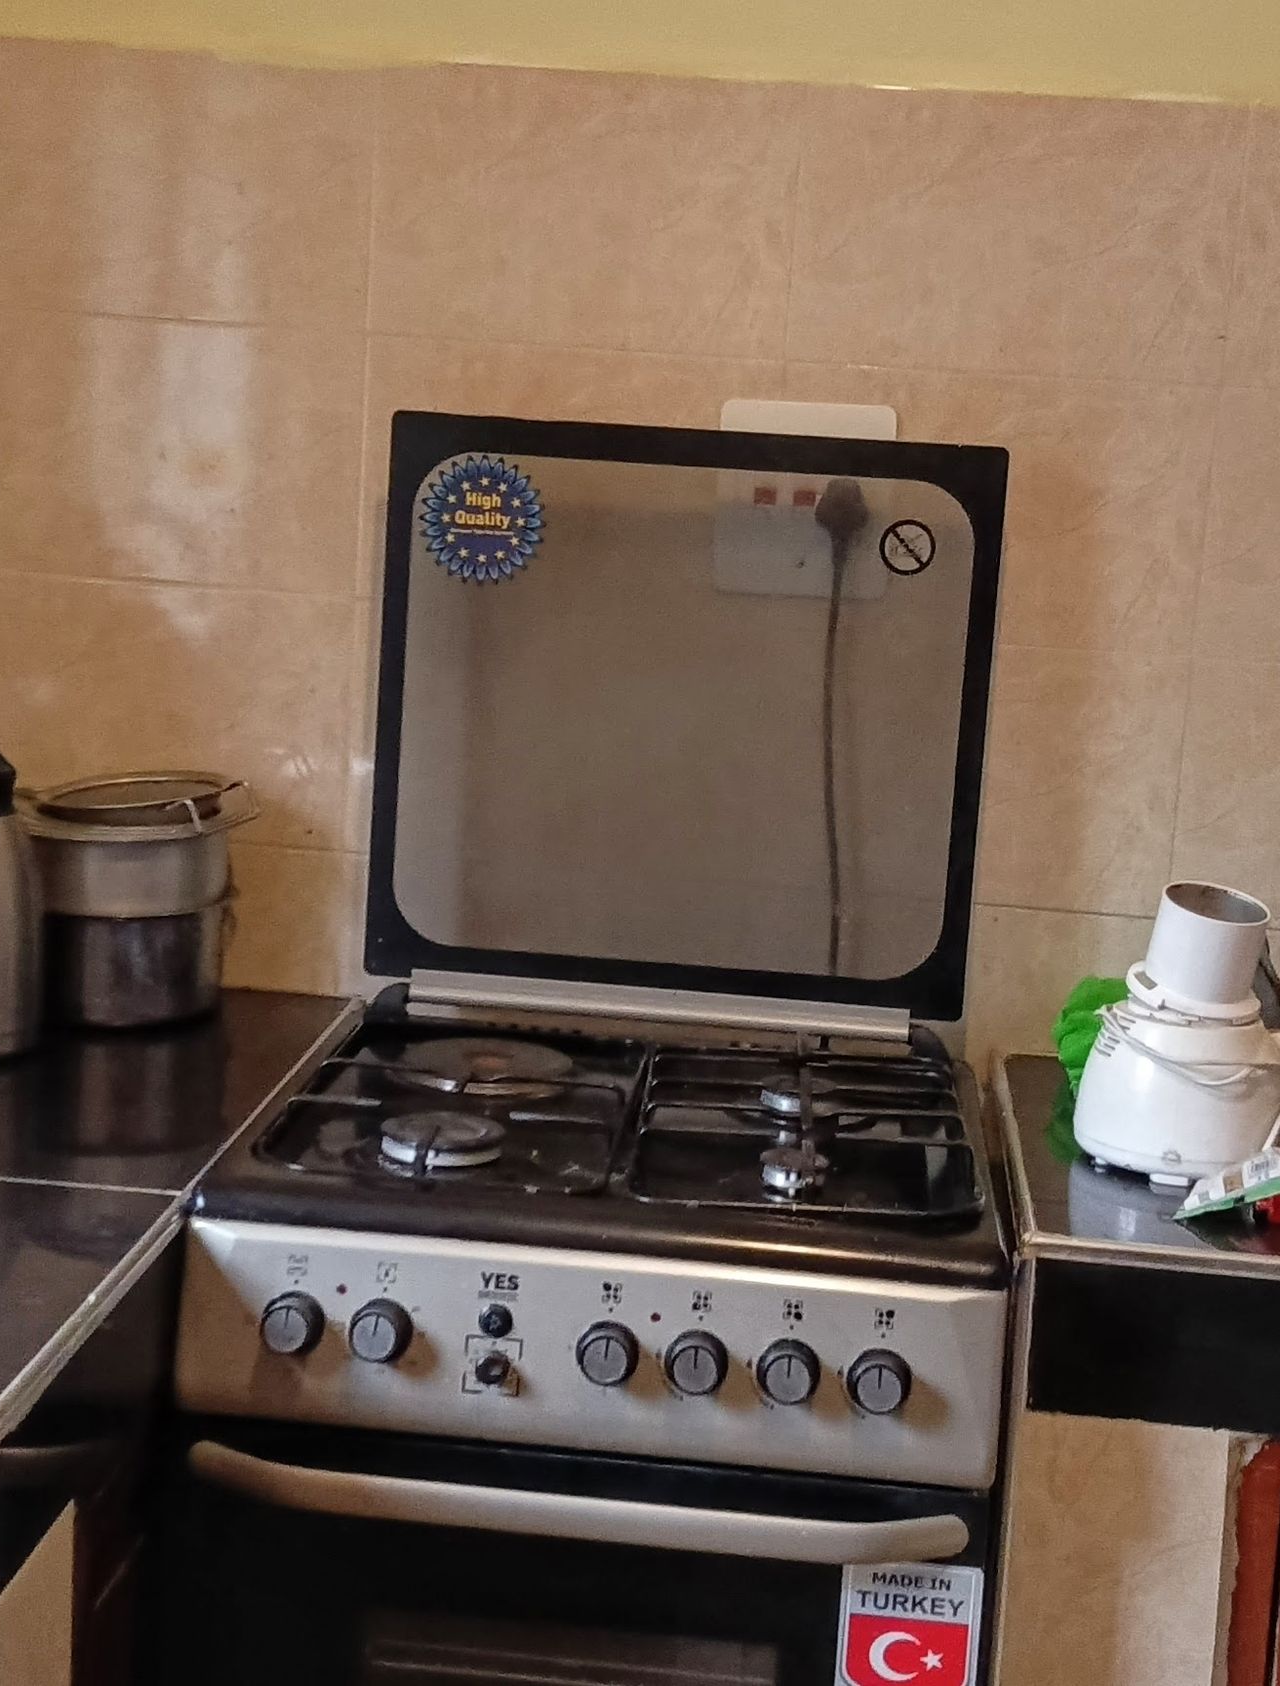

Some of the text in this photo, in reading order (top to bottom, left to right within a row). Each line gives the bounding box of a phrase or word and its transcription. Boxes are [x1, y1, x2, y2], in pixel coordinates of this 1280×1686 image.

[465, 491, 502, 509] High
[454, 510, 511, 529] Quality
[480, 1271, 519, 1291] YES
[872, 1571, 952, 1592] MADE IN
[856, 1590, 964, 1617] TURKEY
